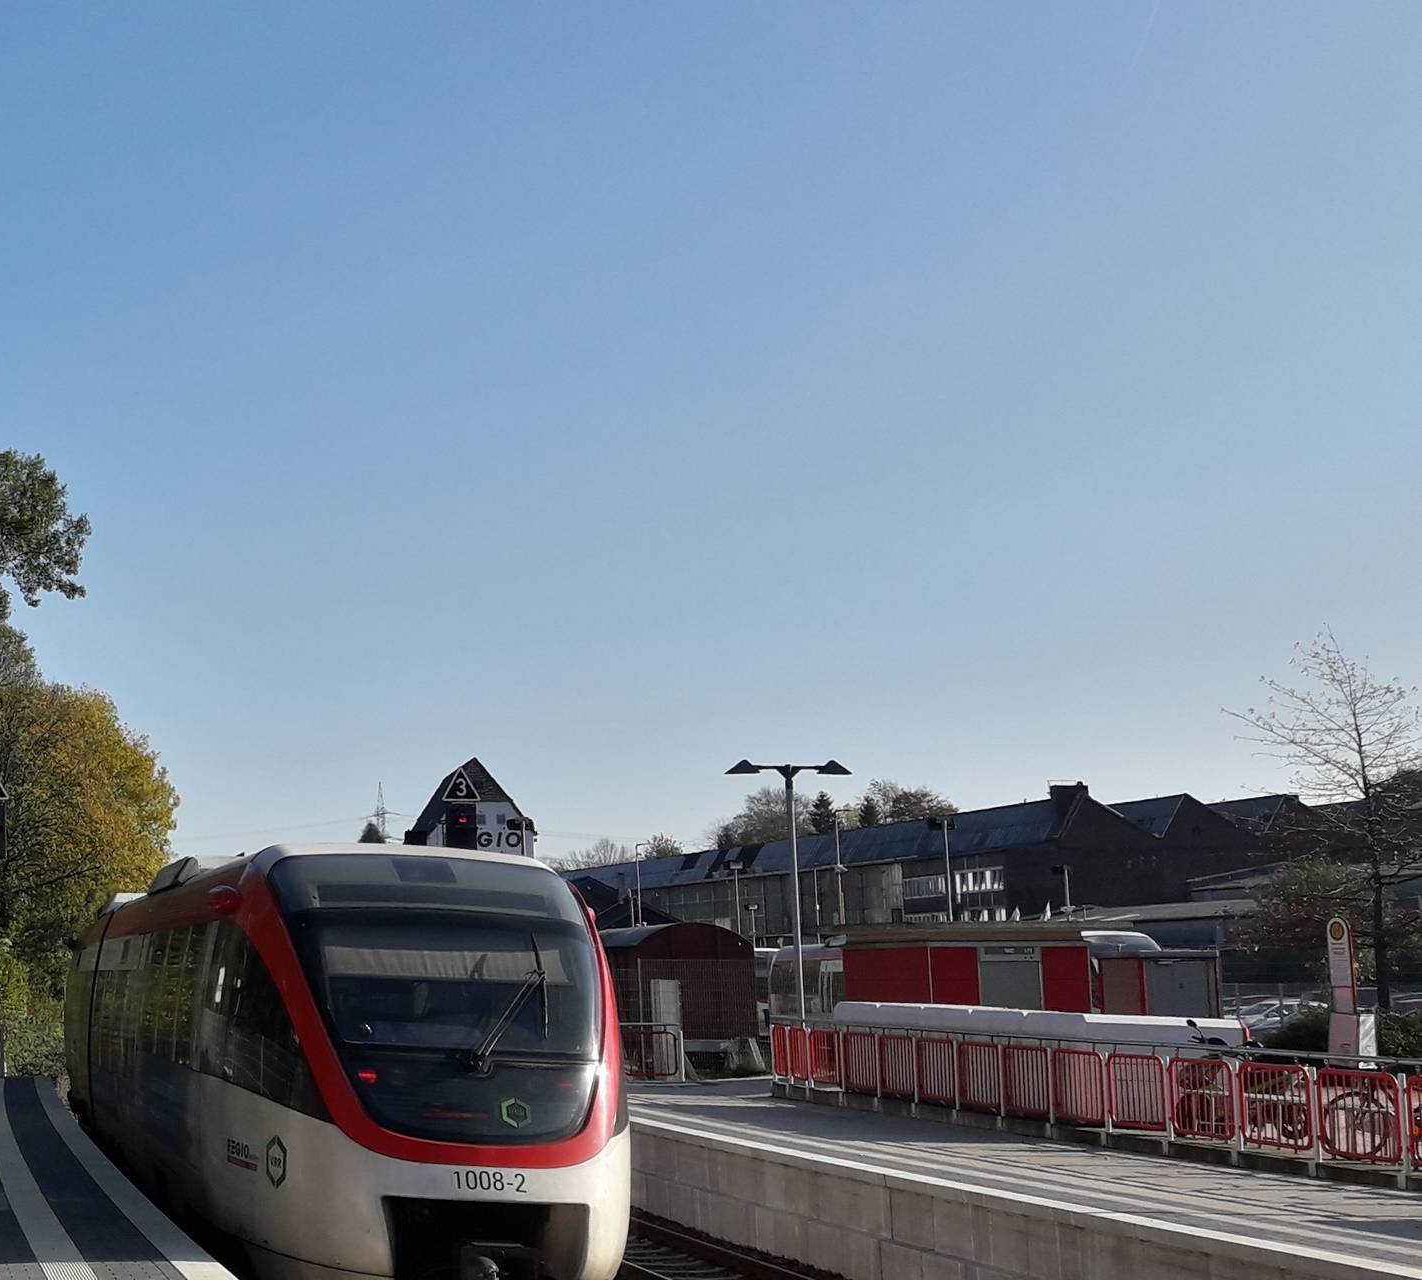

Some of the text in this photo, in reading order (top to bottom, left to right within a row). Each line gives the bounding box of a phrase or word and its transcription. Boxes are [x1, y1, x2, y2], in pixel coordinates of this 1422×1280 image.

[455, 778, 467, 797] 3
[477, 831, 522, 848] GIO
[452, 1169, 528, 1194] 1008-2
